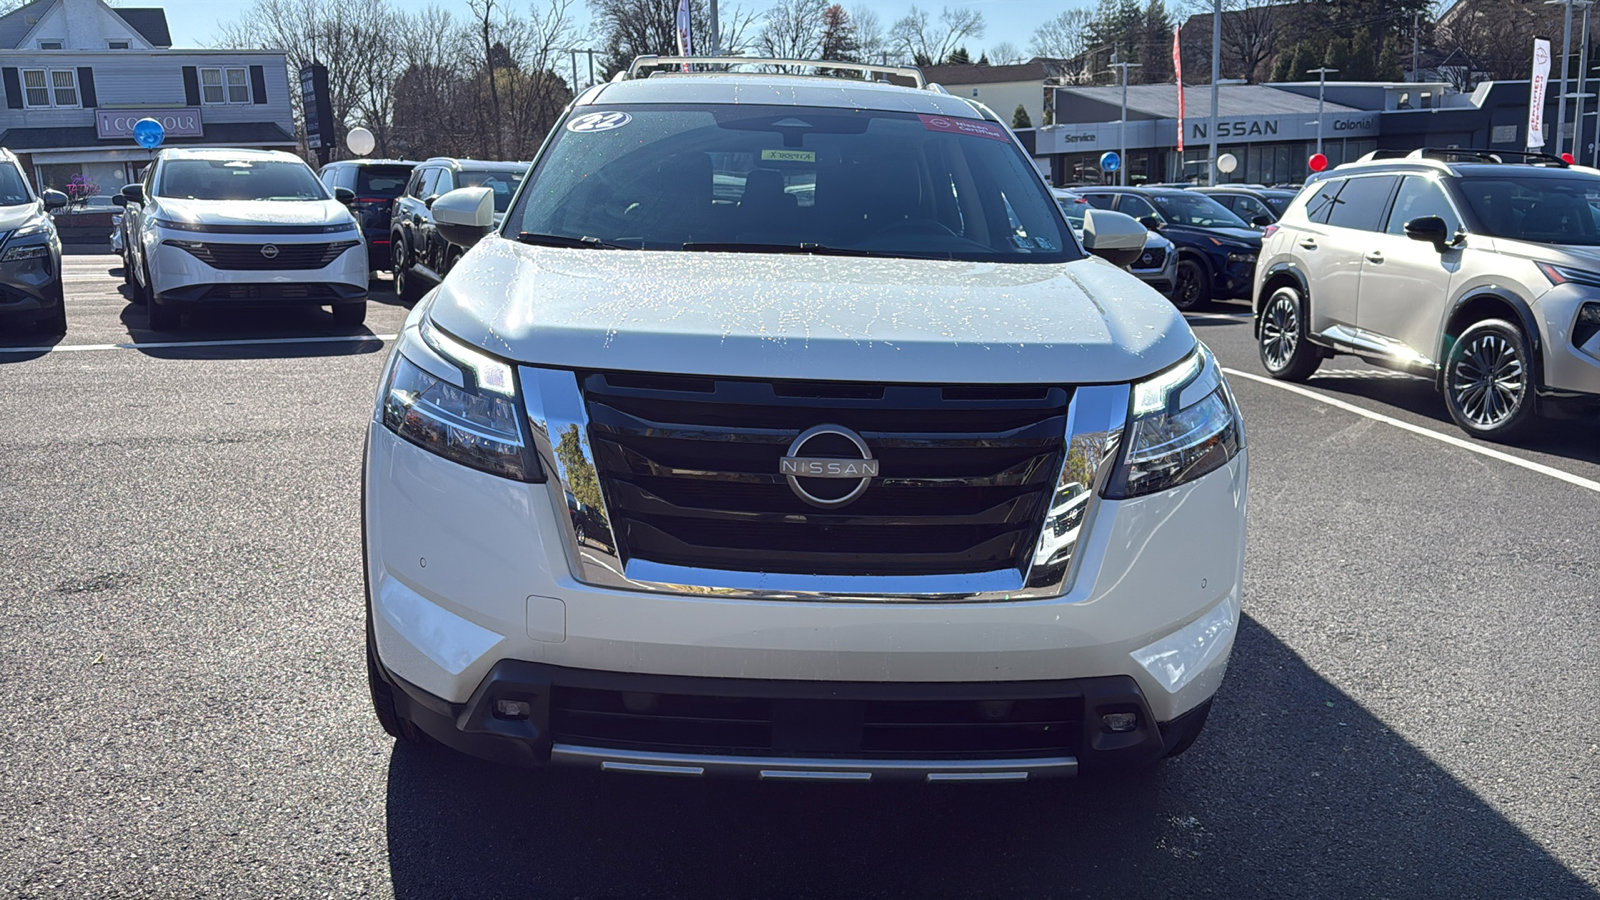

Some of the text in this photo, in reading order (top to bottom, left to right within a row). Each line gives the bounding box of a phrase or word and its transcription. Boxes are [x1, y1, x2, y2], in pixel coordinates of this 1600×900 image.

[574, 113, 624, 130] 22
[1333, 118, 1374, 130] Colonial
[1193, 120, 1278, 138] NSSAN
[1065, 133, 1096, 143] Service
[782, 460, 876, 474] NISSAN
